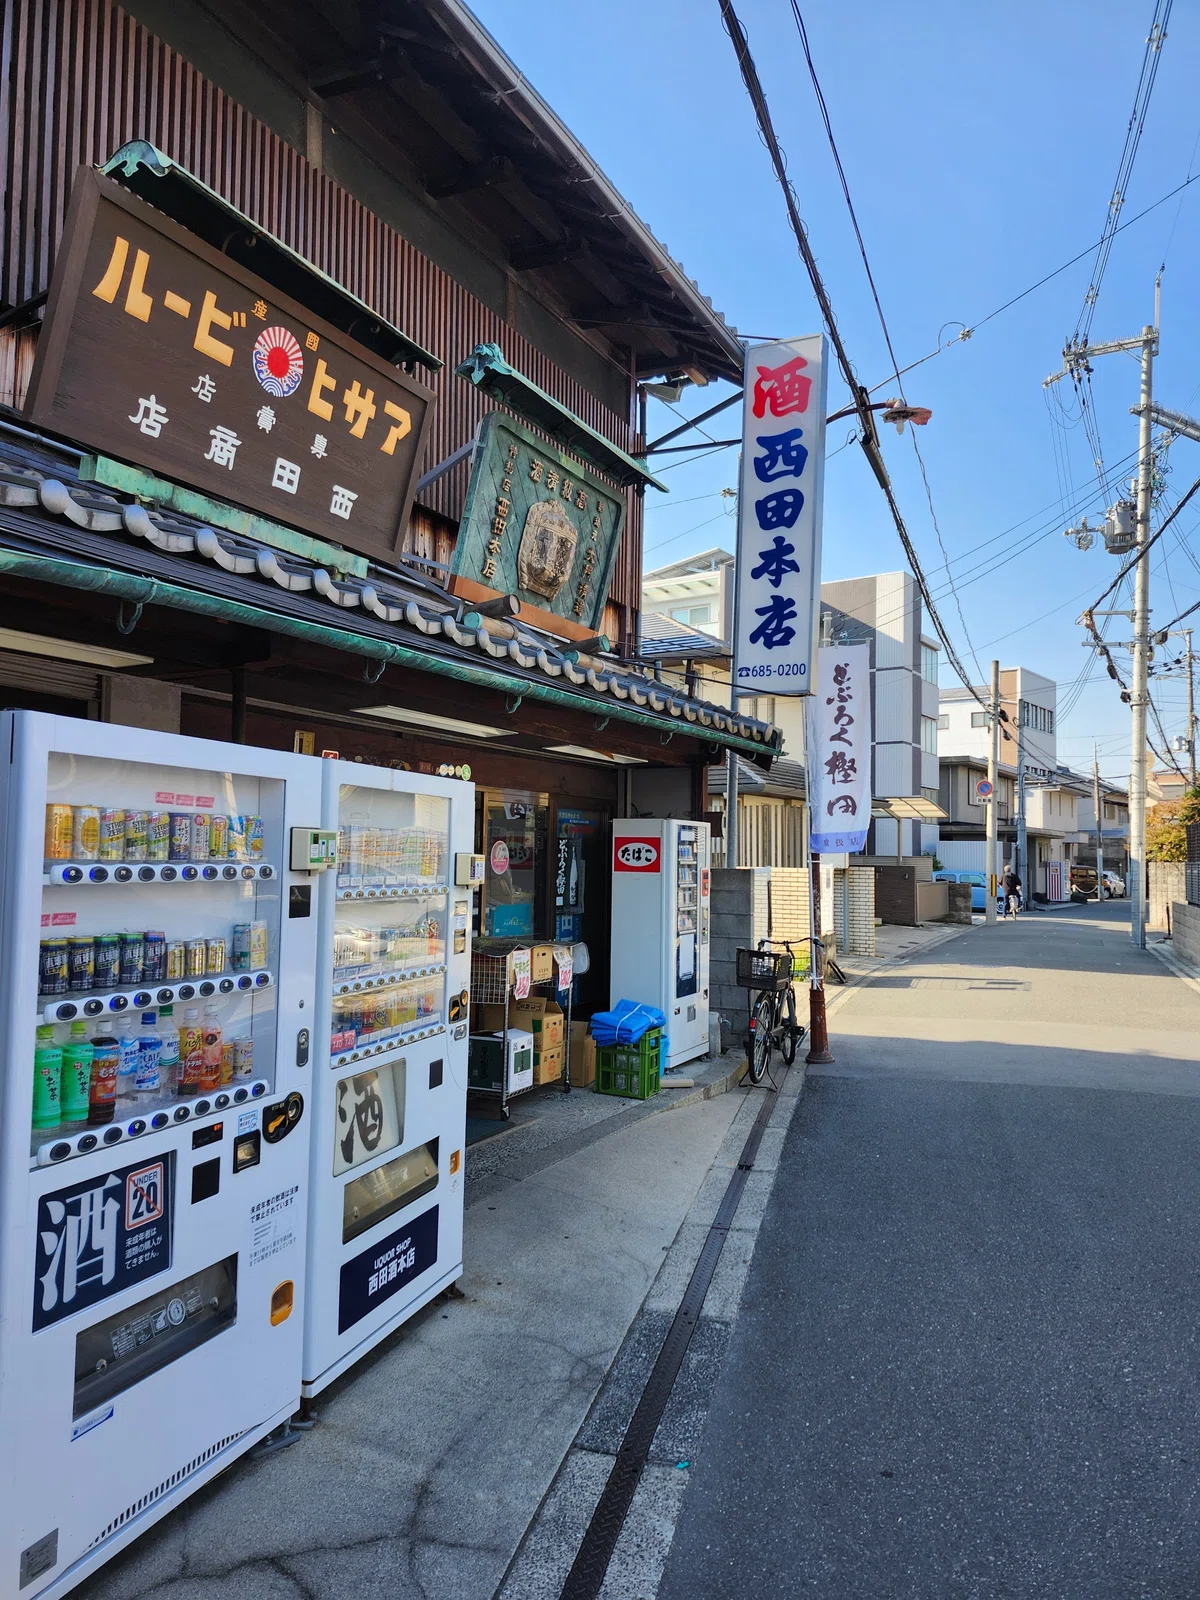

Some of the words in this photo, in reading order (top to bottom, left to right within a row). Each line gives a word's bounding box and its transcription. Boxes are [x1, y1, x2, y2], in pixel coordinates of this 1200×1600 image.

[753, 356, 813, 418] 酒
[129, 394, 359, 520] 西田商店
[749, 428, 809, 650] 西田本店
[751, 663, 807, 678] 685-0200
[621, 846, 653, 863] たばこ
[134, 1171, 158, 1186] UNDER
[132, 1181, 158, 1220] 20
[39, 1173, 123, 1313] 酒
[396, 1236, 411, 1255] SHOP
